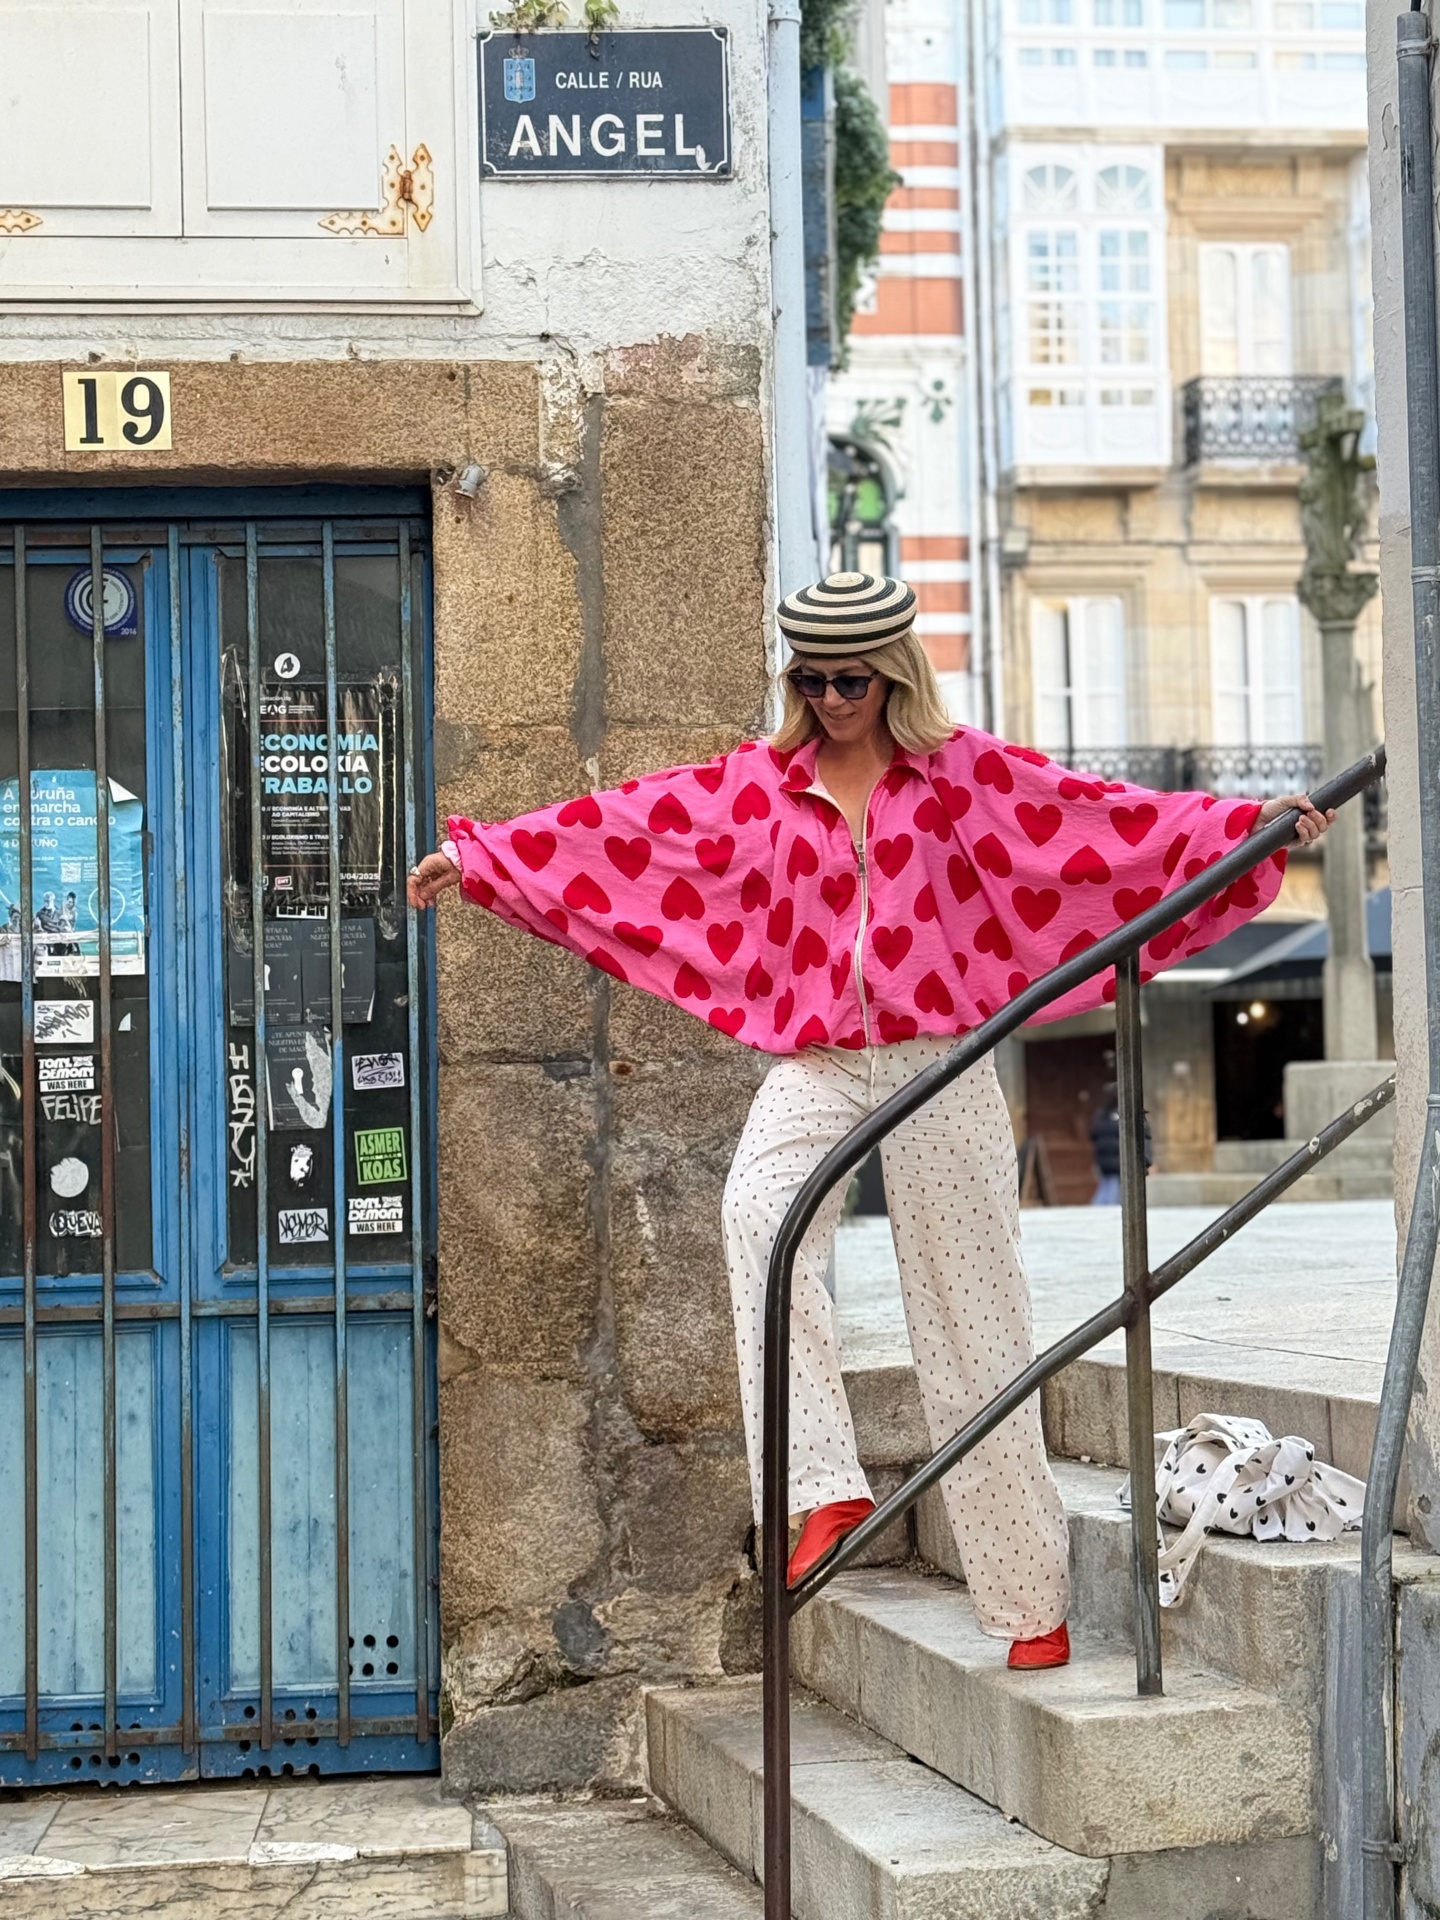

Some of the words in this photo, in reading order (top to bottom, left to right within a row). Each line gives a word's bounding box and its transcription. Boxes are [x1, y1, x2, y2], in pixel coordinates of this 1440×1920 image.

[555, 71, 609, 89] CALLE
[629, 71, 663, 88] RUA
[508, 113, 697, 157] ANGEL
[77, 376, 165, 445] 19
[120, 628, 137, 636] 2016
[3, 787, 15, 800] A
[30, 786, 75, 800] oruña
[261, 777, 373, 794] RABALO
[3, 815, 51, 826] cotra
[54, 817, 65, 826] o
[67, 817, 117, 826] canco
[47, 1080, 66, 1091] WAS
[67, 1079, 88, 1089] HERE
[360, 1132, 401, 1156] ASMER
[362, 1158, 402, 1181] KOAS
[356, 1222, 375, 1233] WAS
[376, 1221, 396, 1231] HERE
